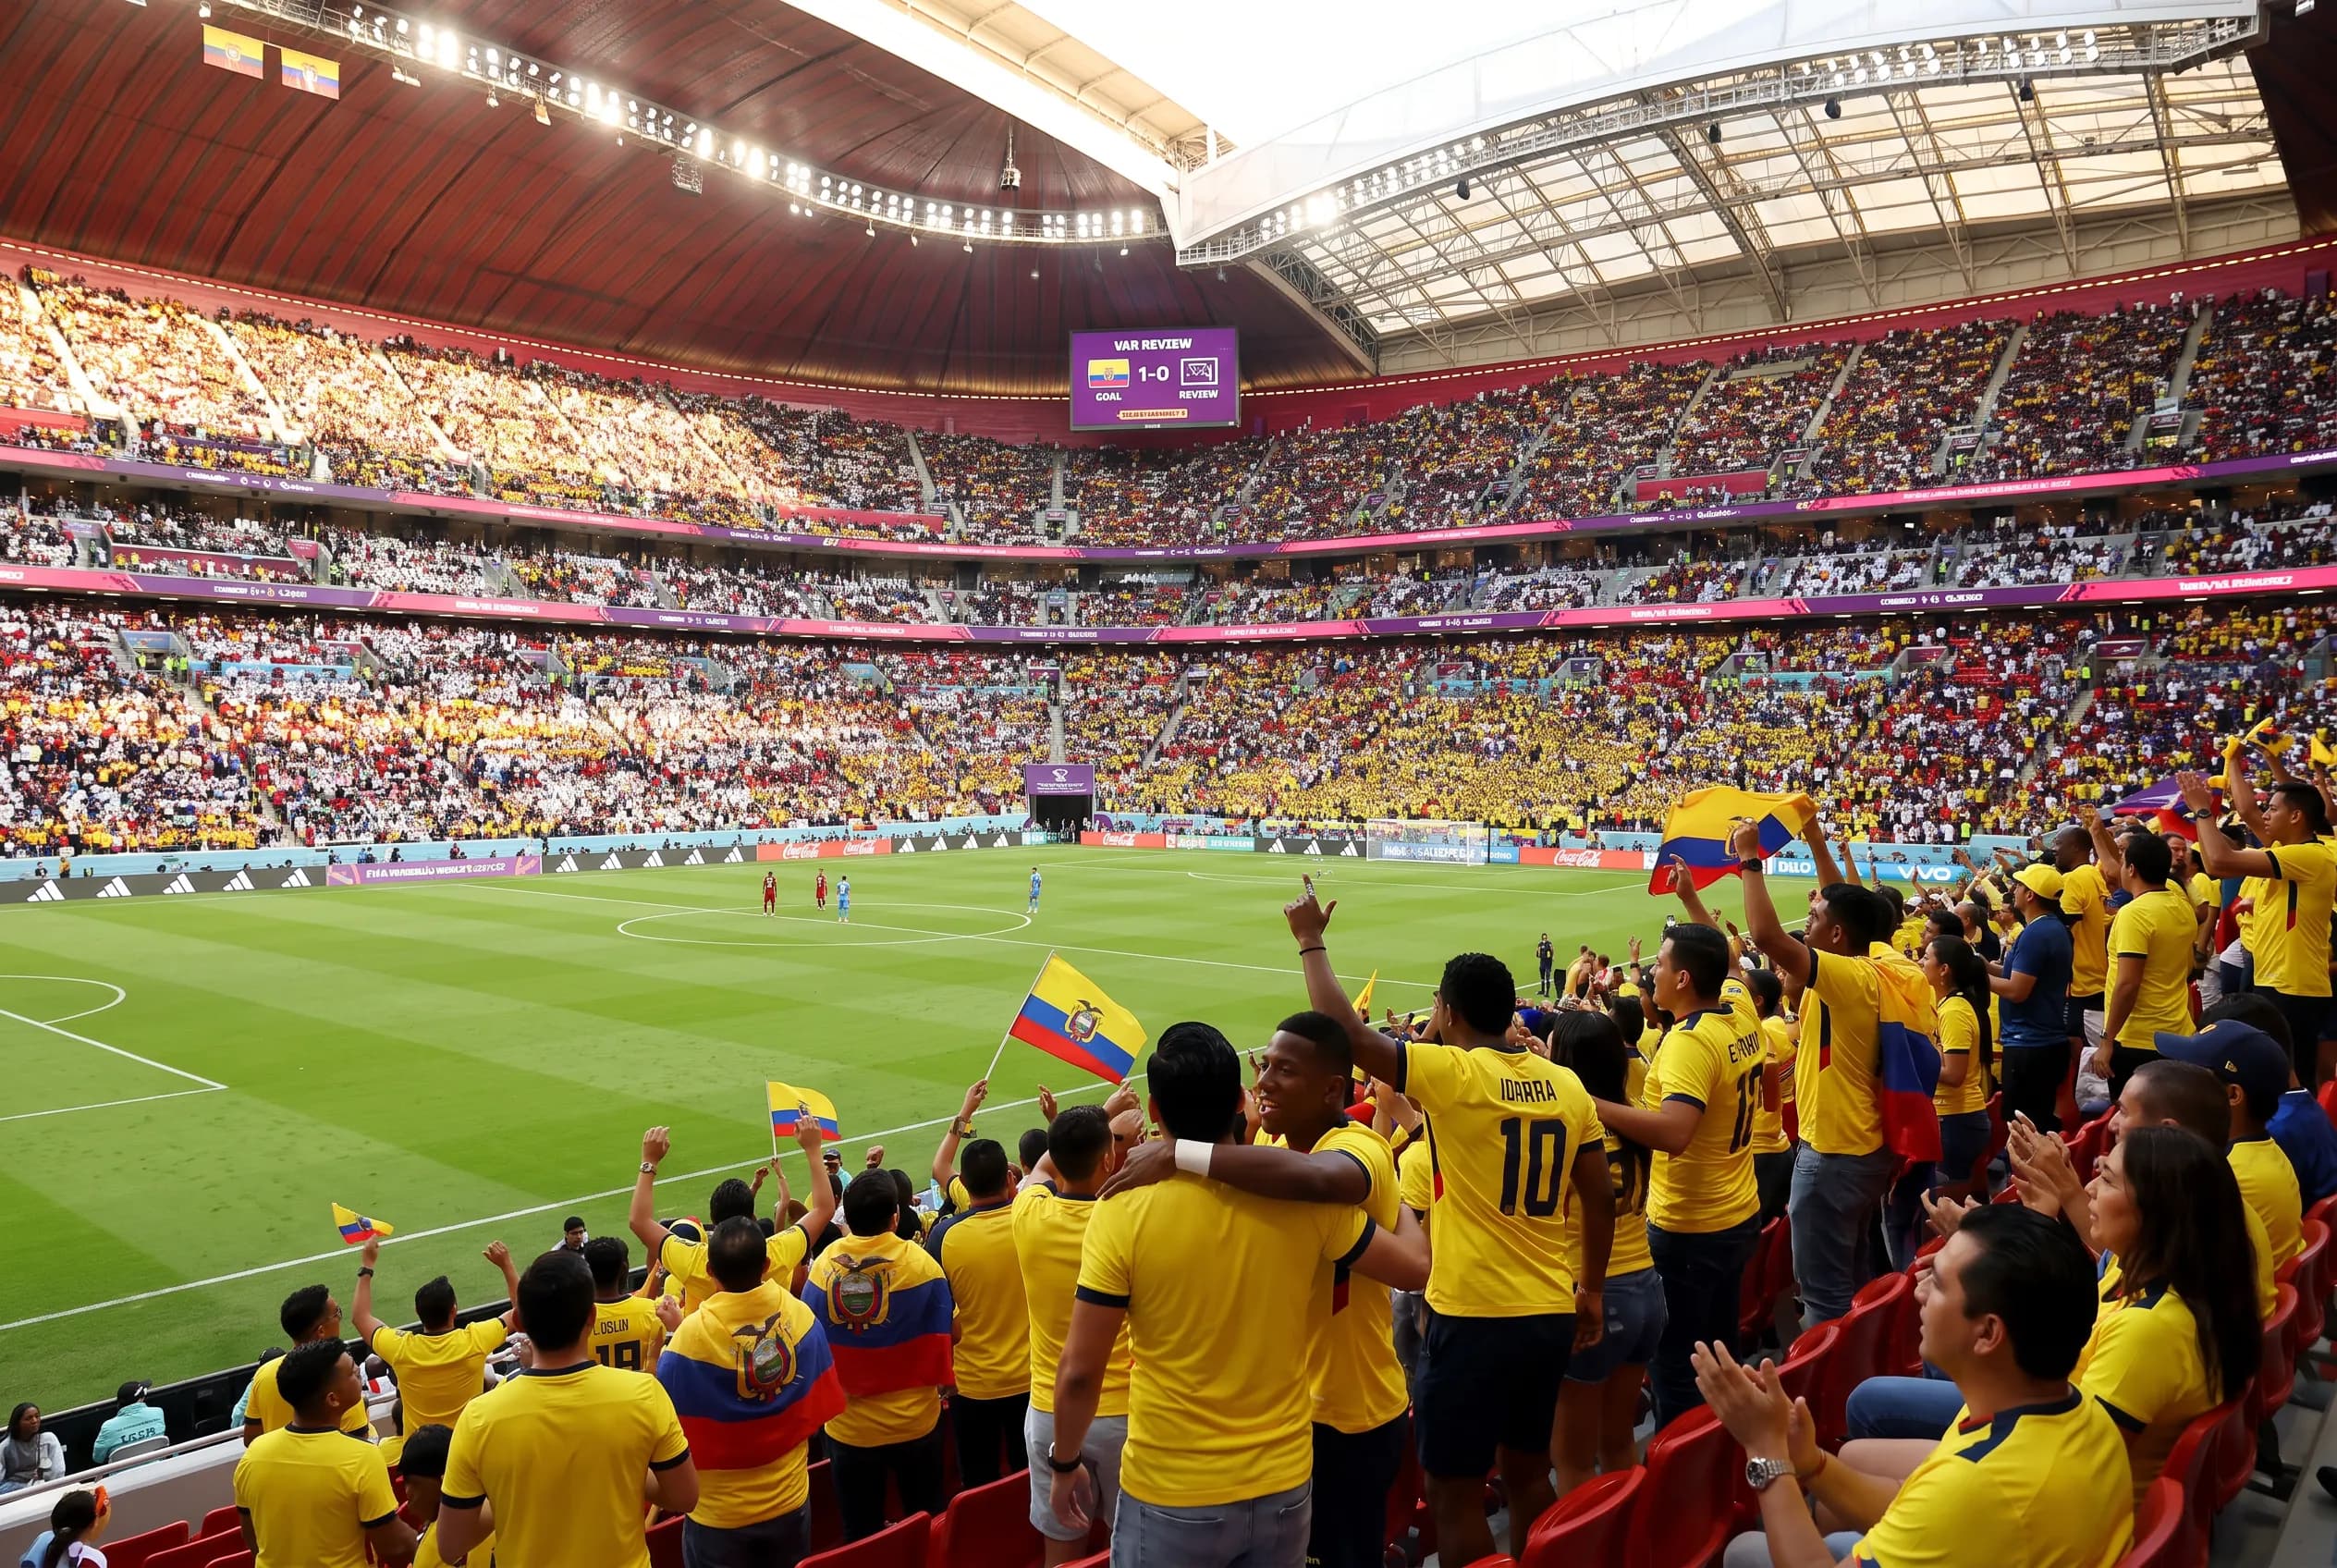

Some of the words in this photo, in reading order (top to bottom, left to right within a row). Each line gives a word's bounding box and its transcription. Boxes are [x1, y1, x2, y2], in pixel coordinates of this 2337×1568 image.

[1114, 339, 1139, 351] VAR
[1142, 338, 1193, 350] REVIEW
[1138, 366, 1169, 382] 1-0
[1095, 392, 1122, 401] GOAL
[1179, 389, 1218, 399] REVIEW
[1499, 1117, 1568, 1217] 10
